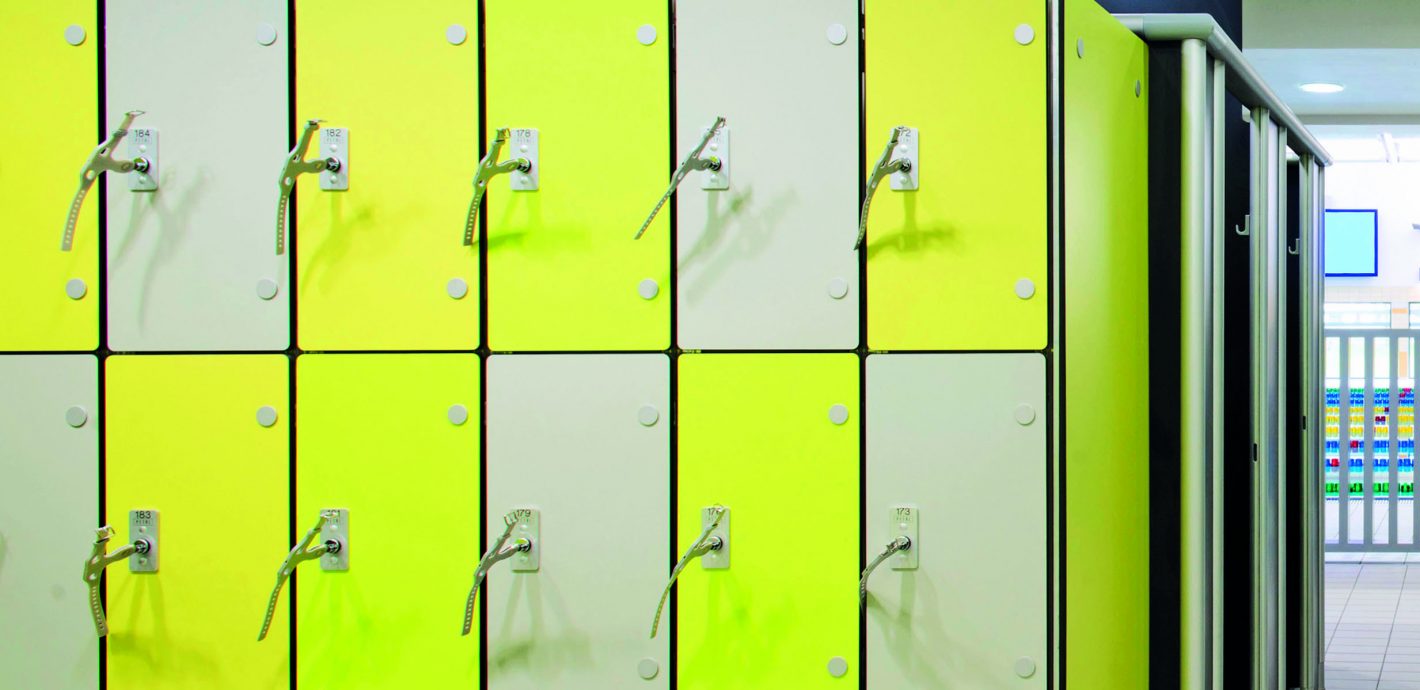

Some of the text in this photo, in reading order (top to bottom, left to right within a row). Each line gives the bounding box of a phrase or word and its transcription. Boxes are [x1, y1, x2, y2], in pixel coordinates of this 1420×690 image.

[135, 129, 151, 138] 184
[326, 129, 341, 137] 182
[516, 129, 531, 137] 178
[135, 510, 151, 519] 183
[516, 509, 531, 517] 179
[896, 508, 911, 516] 173
